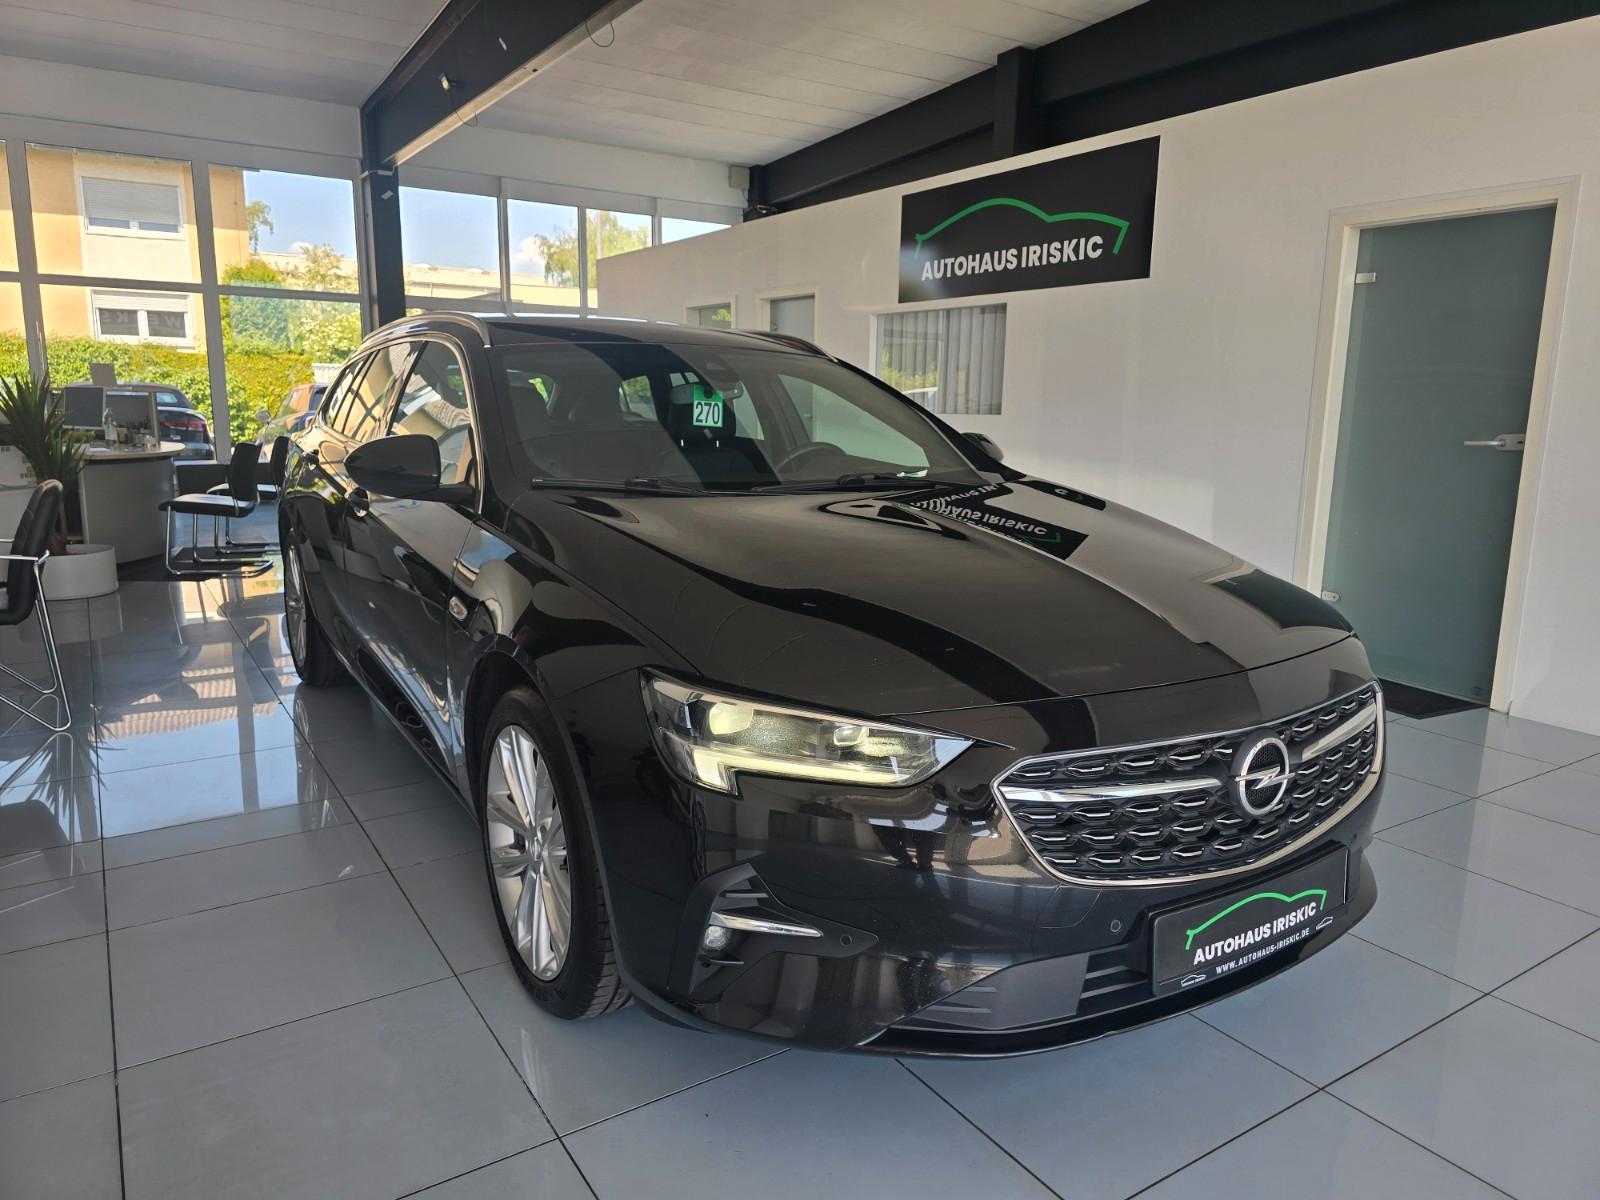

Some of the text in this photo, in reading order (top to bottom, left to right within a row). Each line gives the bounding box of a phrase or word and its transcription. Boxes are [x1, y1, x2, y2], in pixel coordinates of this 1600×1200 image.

[921, 235, 1103, 281] AUTOHAUS IRISKIC
[695, 401, 720, 425] 270
[1193, 902, 1317, 965] AUTOHAUS IRISKIC
